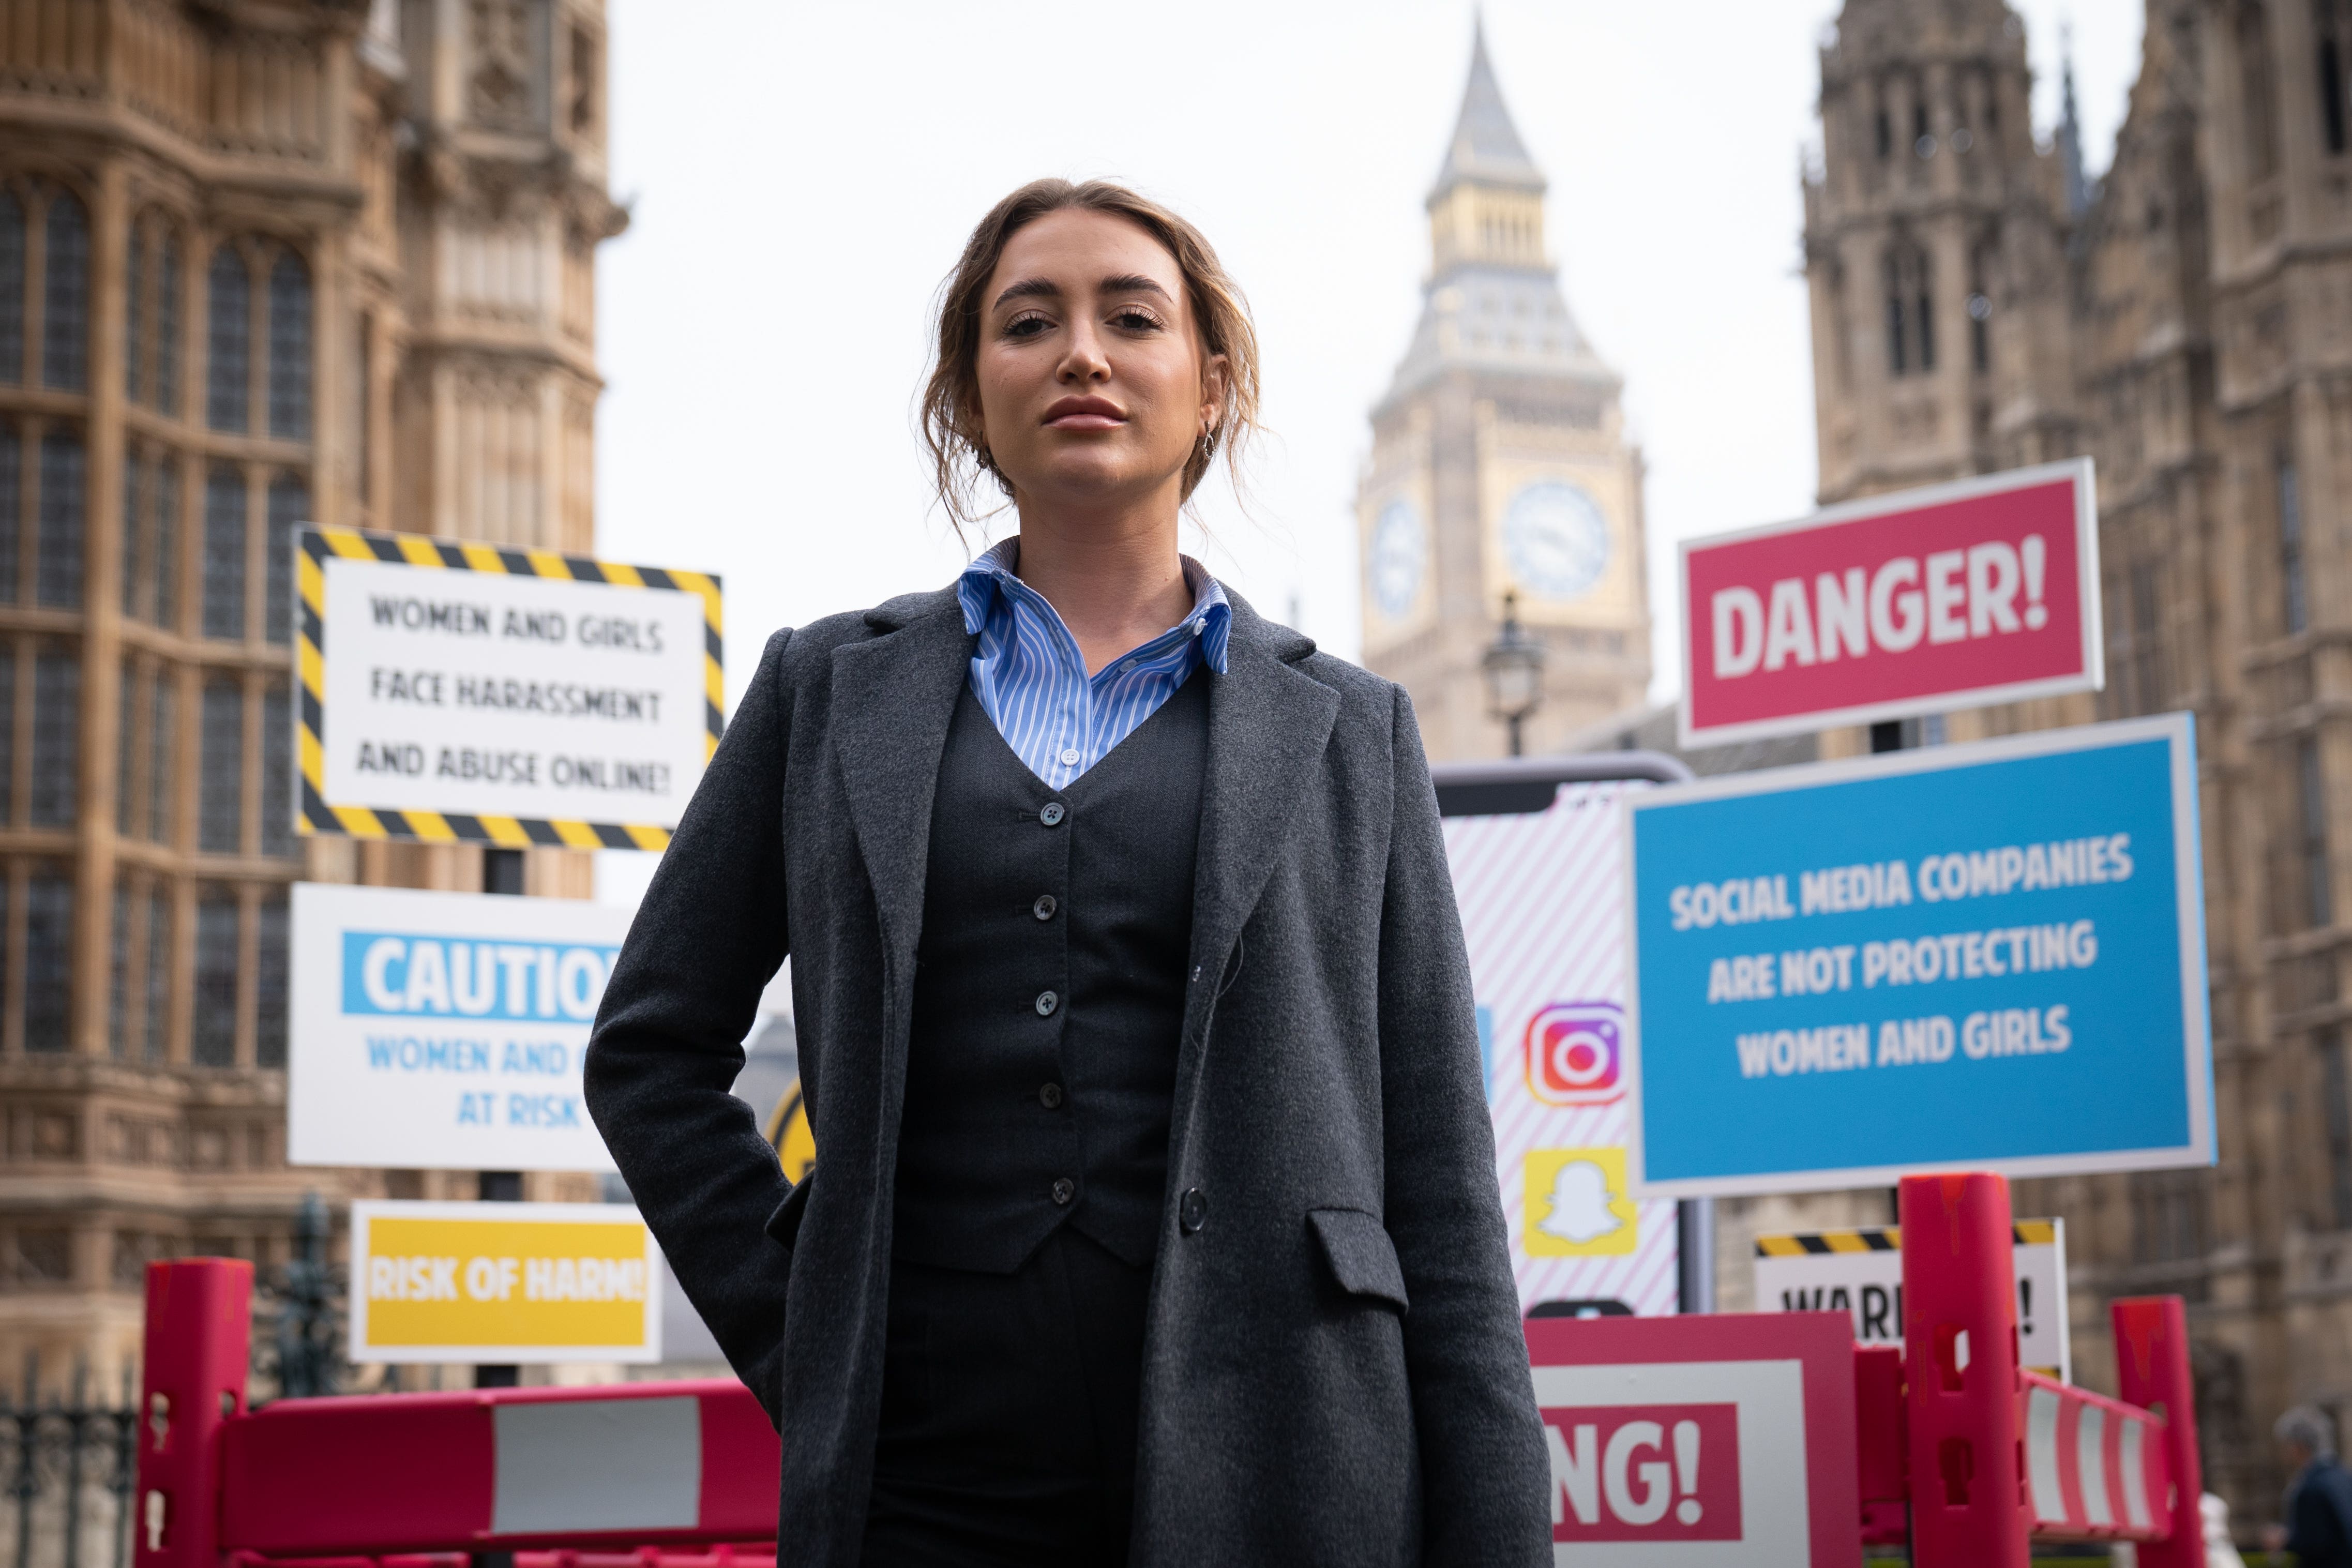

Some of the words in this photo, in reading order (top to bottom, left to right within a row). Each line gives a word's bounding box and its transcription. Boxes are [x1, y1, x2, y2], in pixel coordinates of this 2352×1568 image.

[370, 594, 490, 635] WOMEN
[503, 612, 566, 645] AND
[578, 616, 662, 653] GIRLS
[1712, 534, 2047, 679] DANGER!
[371, 667, 446, 705] FACE
[457, 678, 662, 723] HARASSMENT
[357, 741, 424, 774] AND
[437, 750, 537, 786] ABUSE
[550, 758, 671, 794] ONLINE!
[1670, 874, 1794, 930] SOCIAL
[1801, 861, 1912, 916] MEDIA
[1918, 833, 2134, 902] COMPANIES
[363, 937, 618, 1020] CAUTIO
[1708, 953, 1775, 1003] ARE
[1782, 946, 1856, 997] NOT
[1864, 920, 2098, 988] PROTECTING
[367, 1034, 490, 1074] WOMEN
[503, 1043, 567, 1075] AND
[1737, 1023, 1869, 1078] WOMEN
[1878, 1015, 1954, 1067] AND
[1963, 1005, 2071, 1060] GIRLS
[457, 1092, 494, 1126] AT
[509, 1094, 580, 1128] RISK
[370, 1256, 459, 1301] RISK
[465, 1257, 518, 1299] OF
[525, 1259, 645, 1301] HARM!
[1544, 1420, 1703, 1526] NG!
